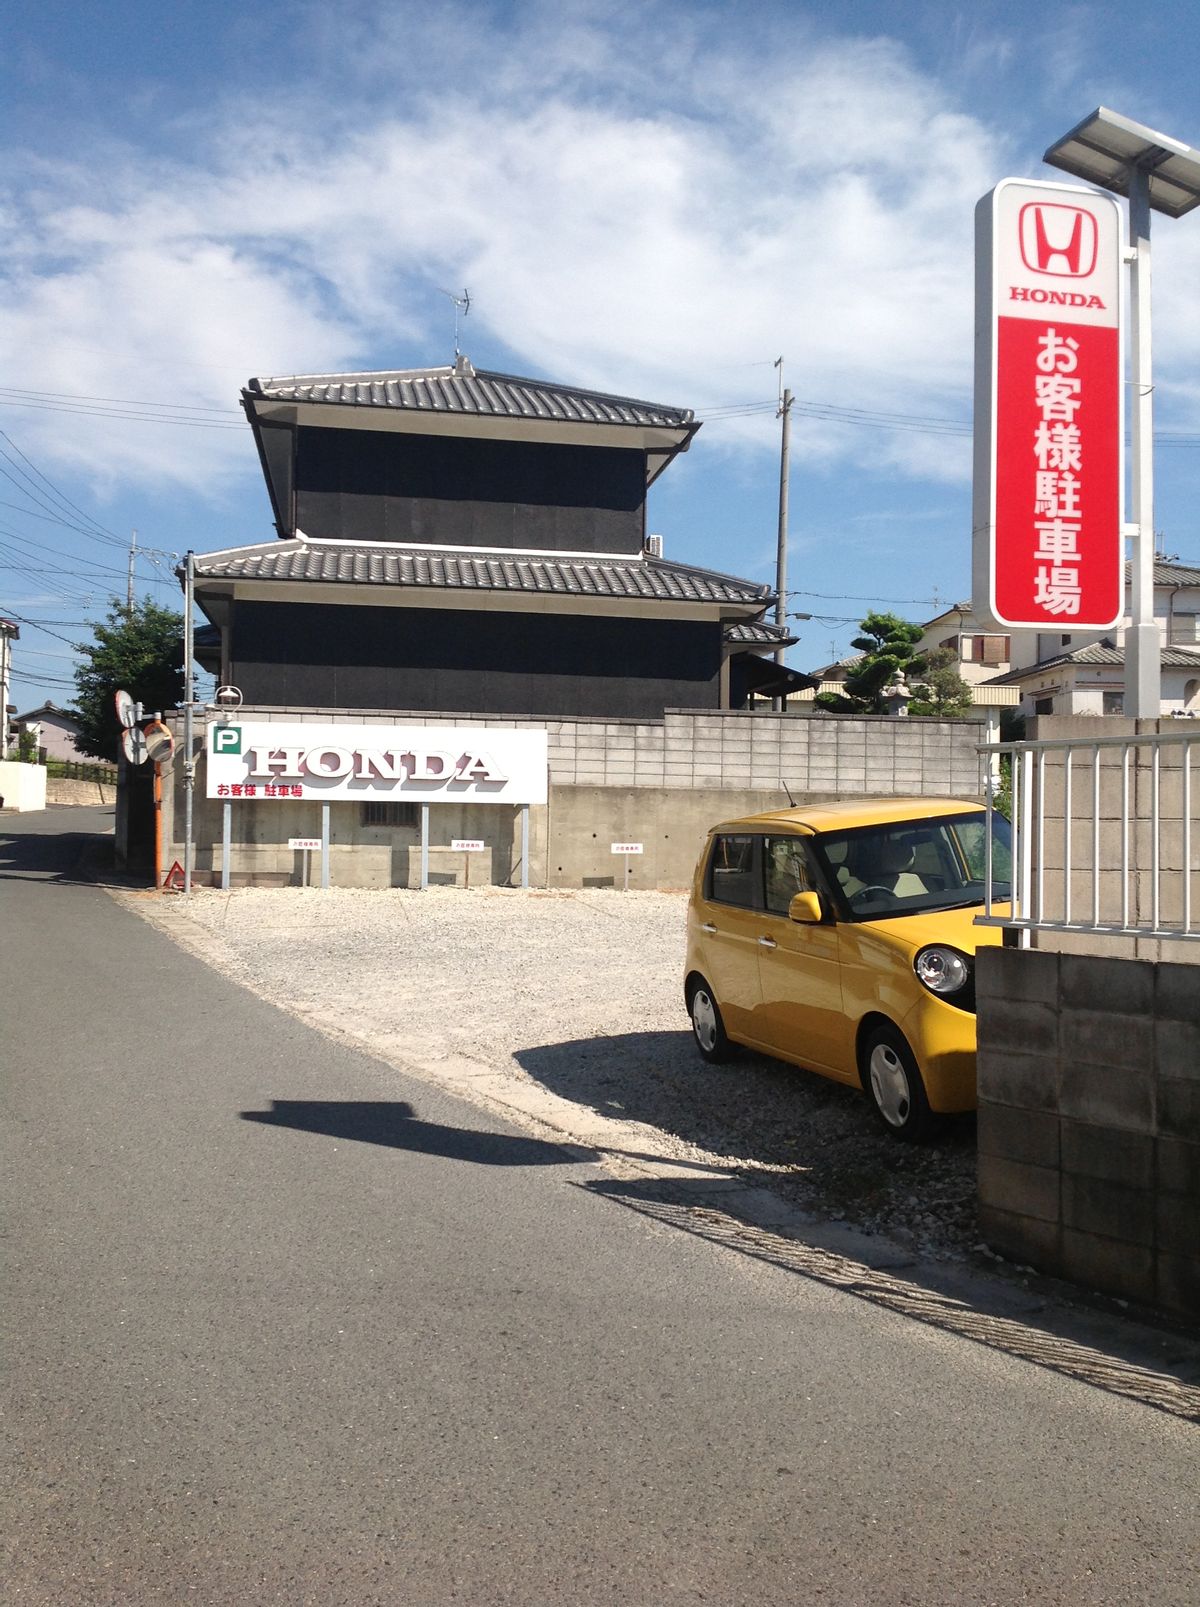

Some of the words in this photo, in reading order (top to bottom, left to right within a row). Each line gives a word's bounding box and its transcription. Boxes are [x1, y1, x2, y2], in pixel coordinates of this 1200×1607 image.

[1009, 286, 1107, 310] HONDA
[1033, 328, 1083, 616] お客様駐車場
[217, 729, 239, 751] P
[249, 746, 510, 784] HONDA
[217, 783, 257, 797] お客様
[264, 784, 304, 798] 駐車場
